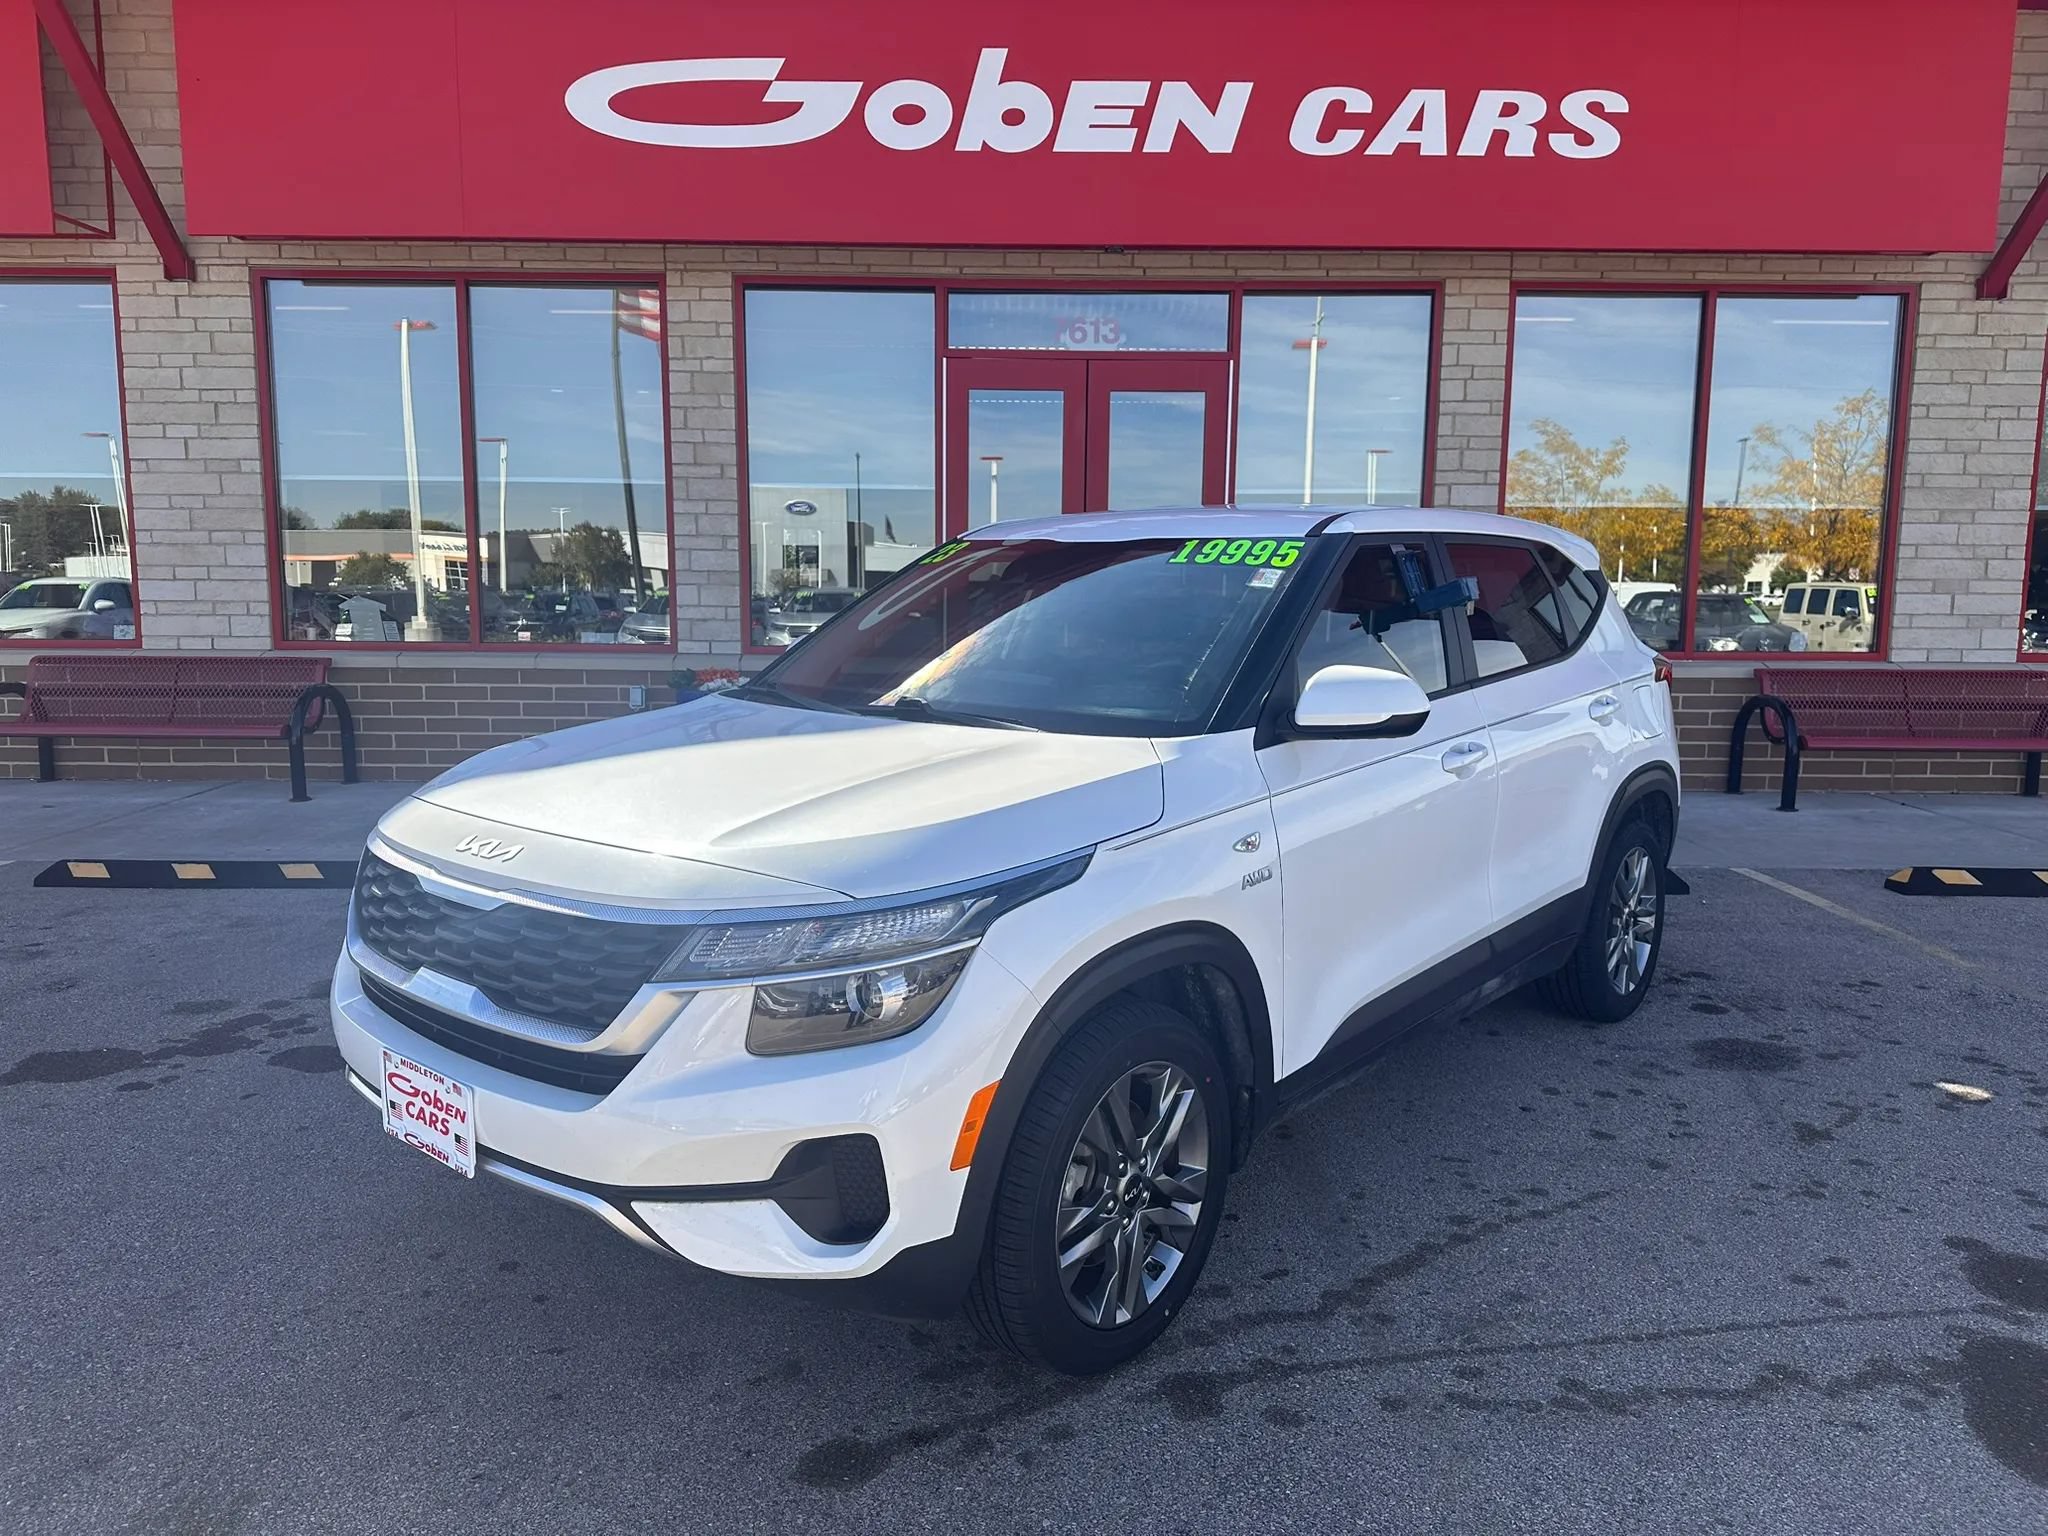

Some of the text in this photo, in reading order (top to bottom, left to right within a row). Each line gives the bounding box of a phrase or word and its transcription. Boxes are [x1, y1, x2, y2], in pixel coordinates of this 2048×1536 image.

[1289, 87, 1630, 159] CARS
[1168, 539, 1306, 567] 19995
[456, 832, 525, 863] KIA
[1241, 866, 1273, 890] AWD
[400, 1058, 445, 1085] MIDDLETON
[405, 1101, 450, 1136] CARS
[386, 1126, 399, 1139] USA
[454, 1164, 468, 1177] USA
